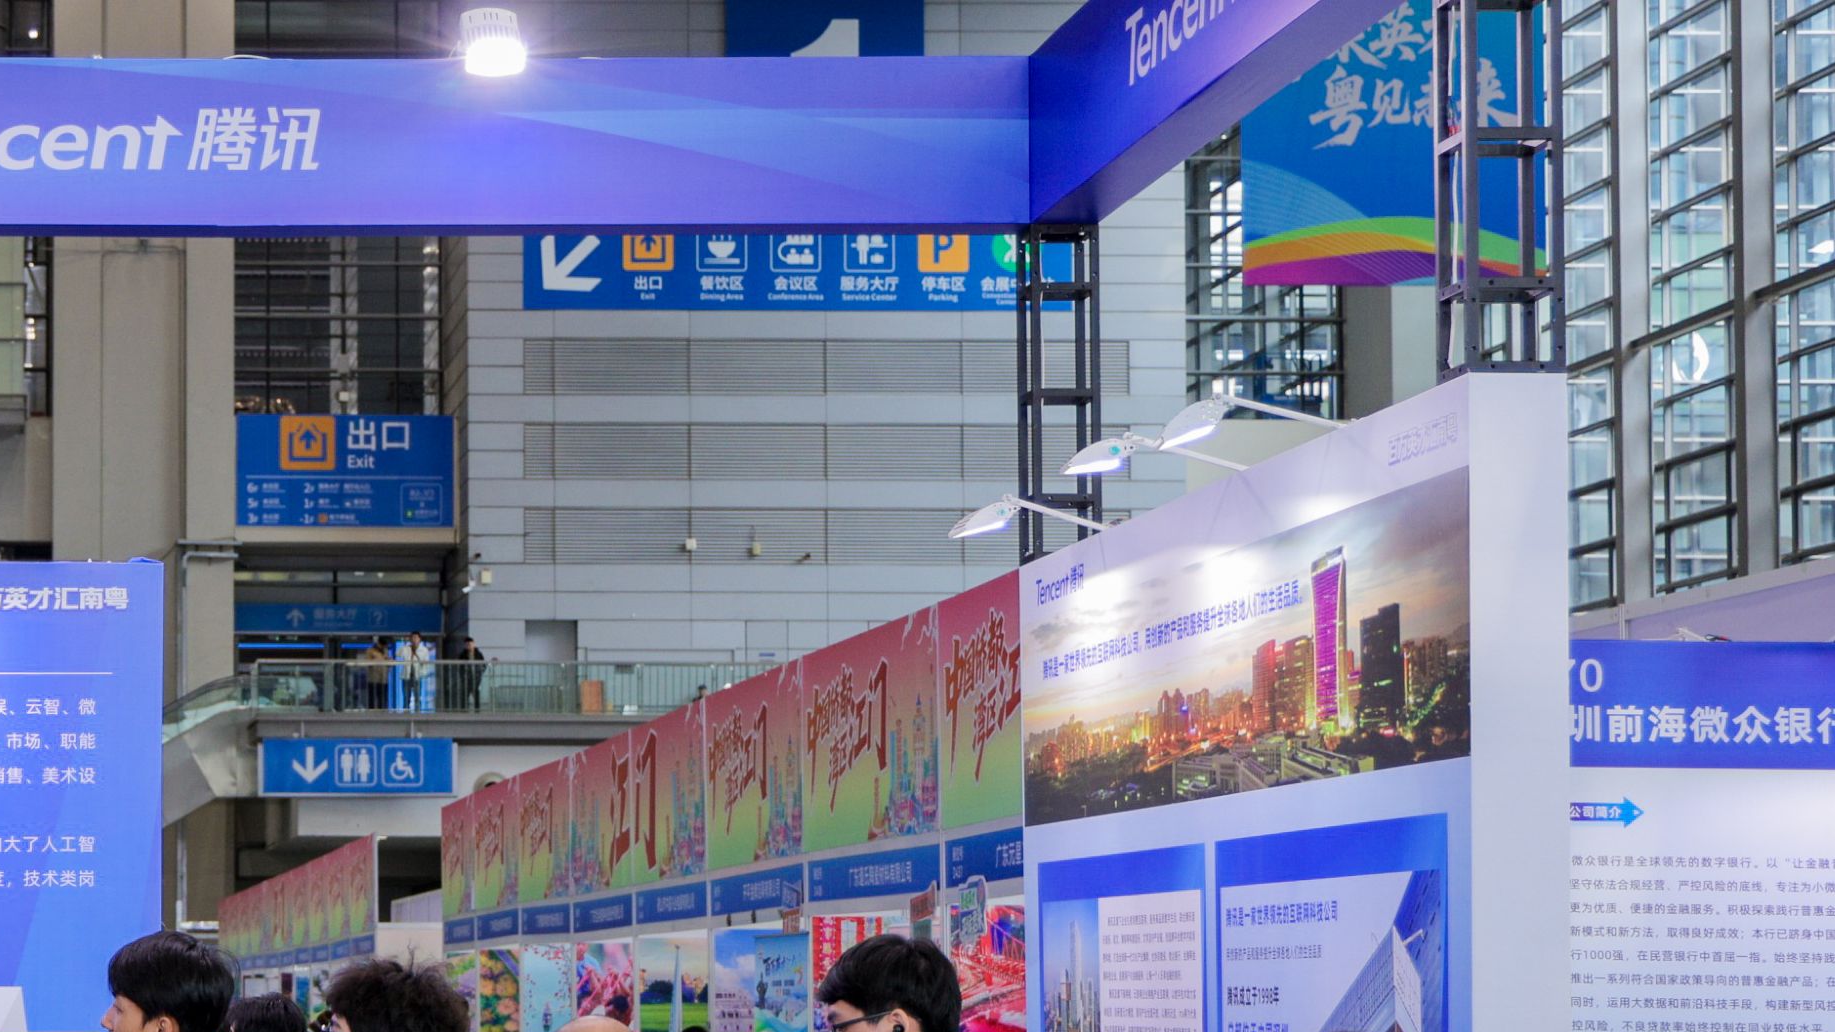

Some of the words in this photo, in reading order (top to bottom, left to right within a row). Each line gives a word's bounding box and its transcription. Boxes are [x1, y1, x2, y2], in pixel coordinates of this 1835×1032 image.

[1125, 0, 1224, 86] Tencen
[186, 106, 322, 172] 腾讯
[634, 275, 663, 291] 出口
[700, 275, 744, 291] 餐饮区
[774, 275, 818, 291] 会议区
[840, 276, 900, 292] 服务大厅
[921, 276, 966, 292] 停车区
[347, 418, 410, 451] 出口
[347, 454, 375, 469] Exit
[1036, 573, 1069, 607] Tencent
